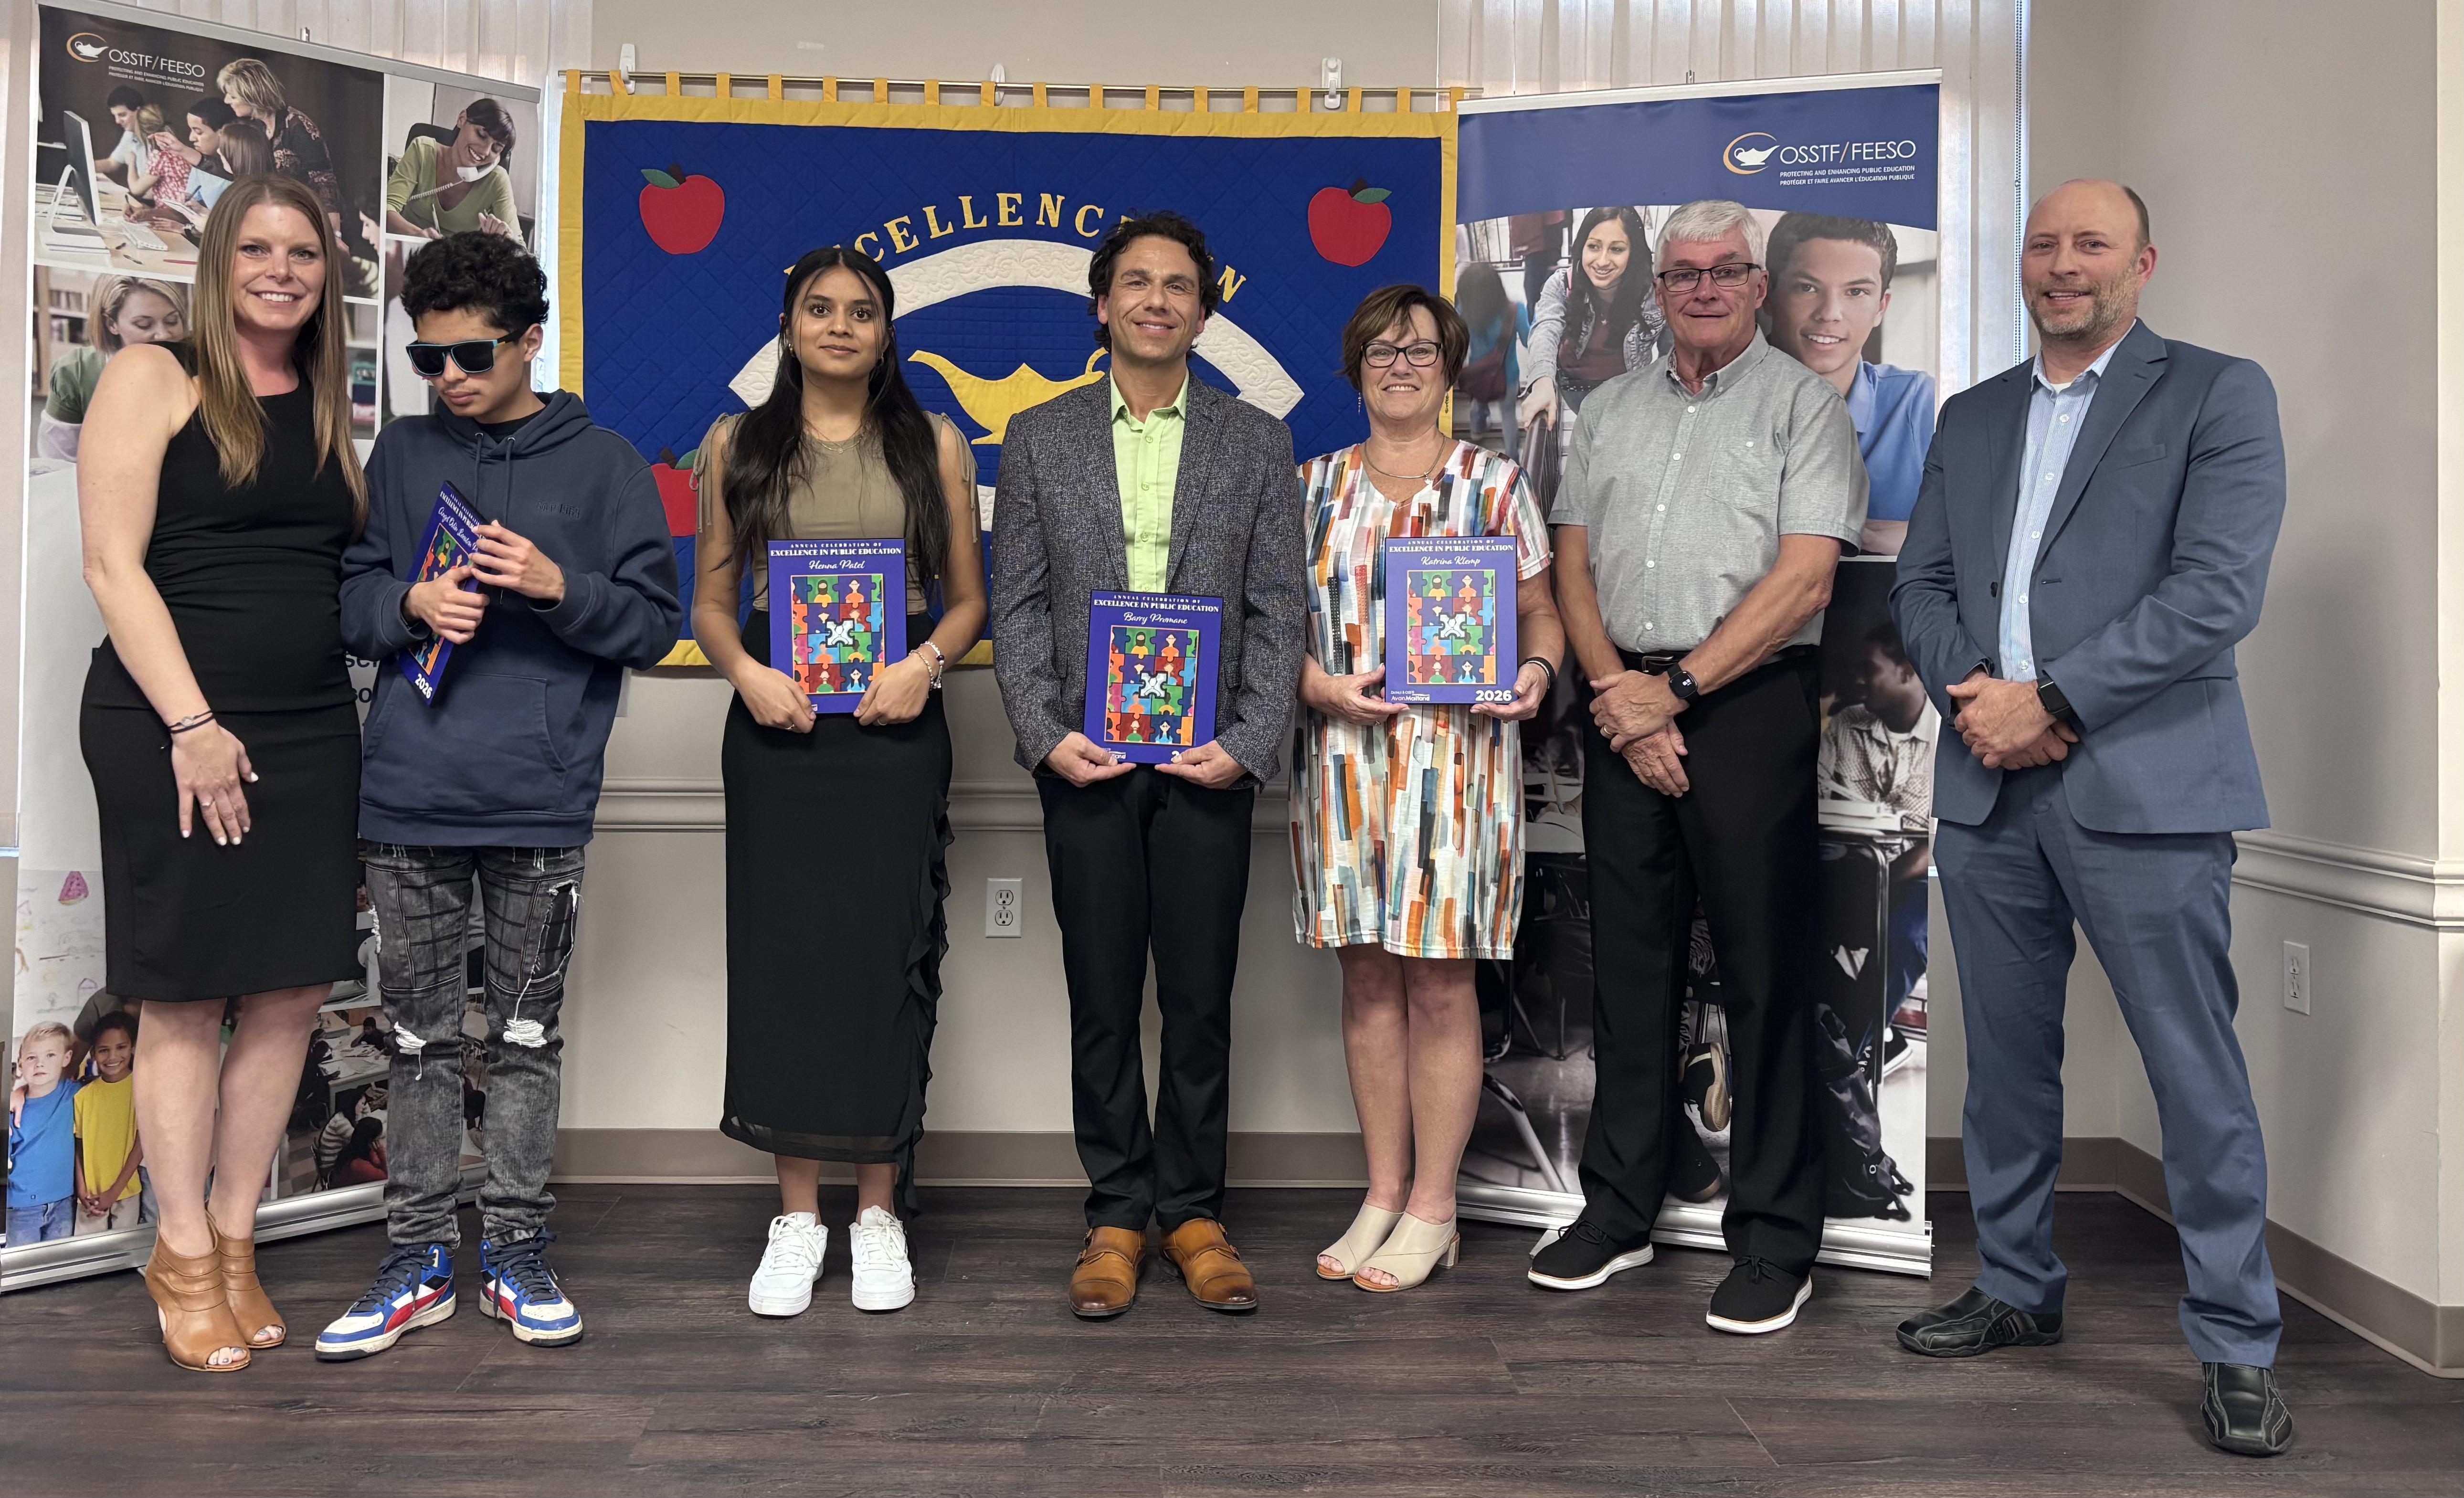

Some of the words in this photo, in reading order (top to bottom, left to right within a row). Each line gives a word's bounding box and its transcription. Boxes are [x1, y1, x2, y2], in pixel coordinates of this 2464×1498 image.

[109, 49, 205, 77] OSSTF/FEESO
[1780, 140, 1916, 164] OSSTF/FEESO
[784, 192, 1134, 275] CELLENC
[809, 560, 838, 569] Henna
[839, 559, 865, 569] Patel
[1421, 556, 1453, 565] Katrina
[1094, 599, 1139, 608] EXCELLENCE
[1123, 612, 1148, 625] Barry
[415, 673, 433, 699] 2026
[1475, 690, 1512, 701] 2026
